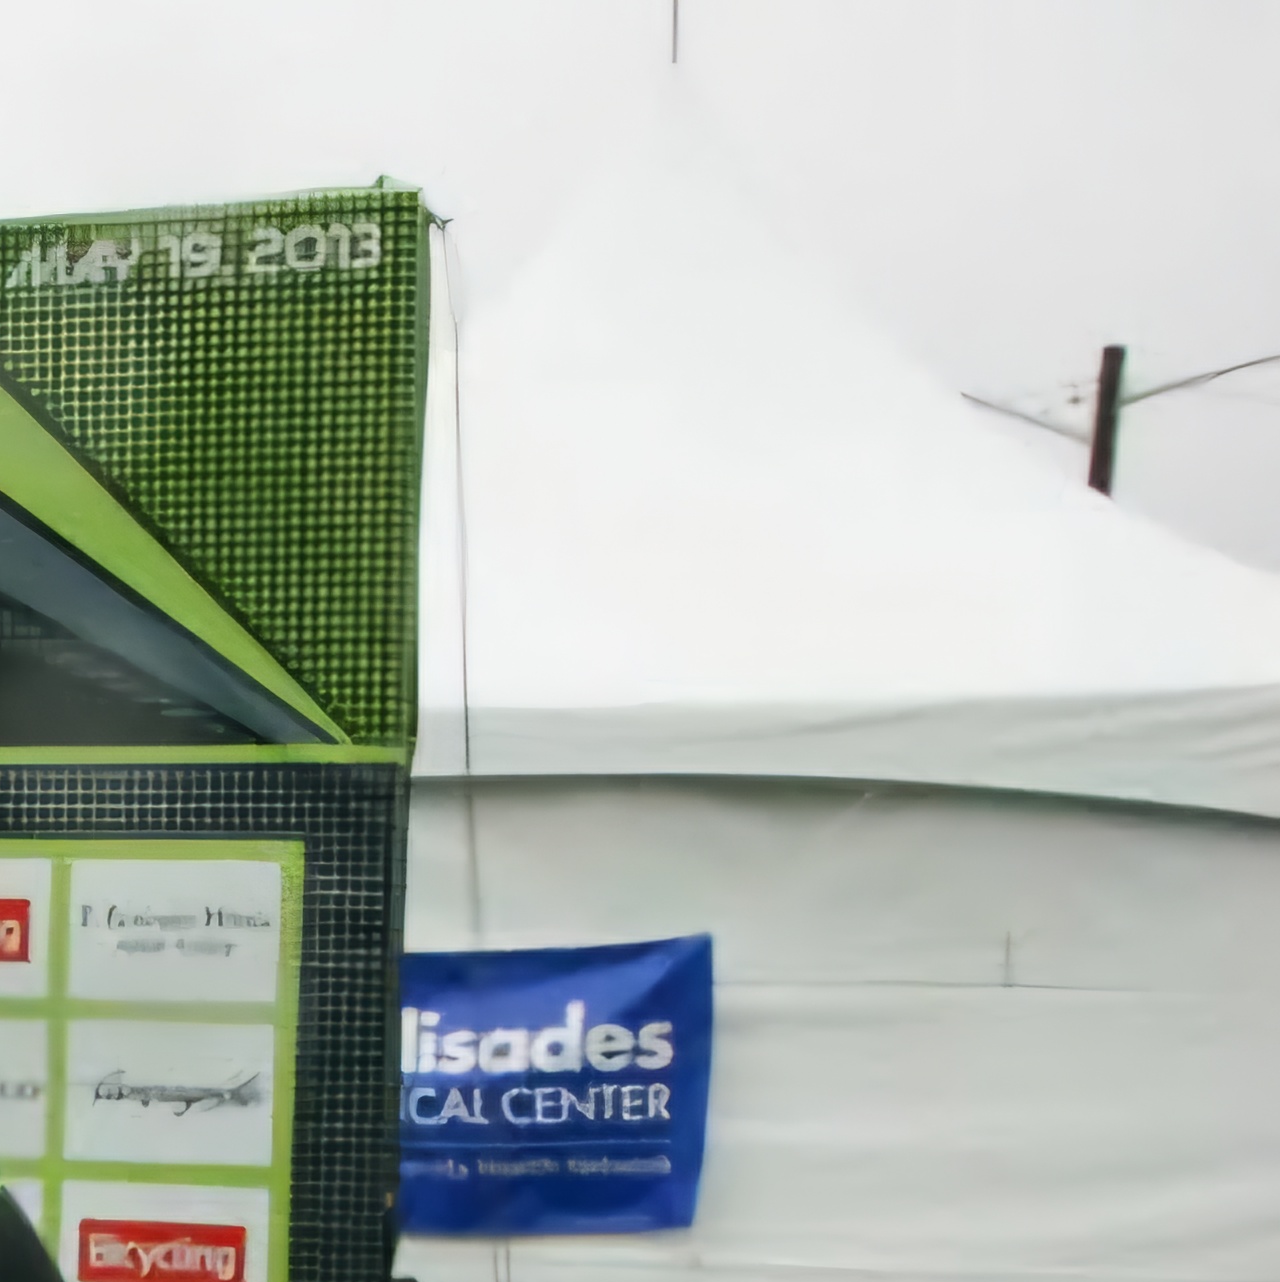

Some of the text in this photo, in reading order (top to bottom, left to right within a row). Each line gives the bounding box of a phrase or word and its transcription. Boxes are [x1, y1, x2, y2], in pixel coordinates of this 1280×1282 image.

[247, 222, 383, 274] 2013
[401, 999, 674, 1074] lisades
[501, 1081, 671, 1126] CENTER
